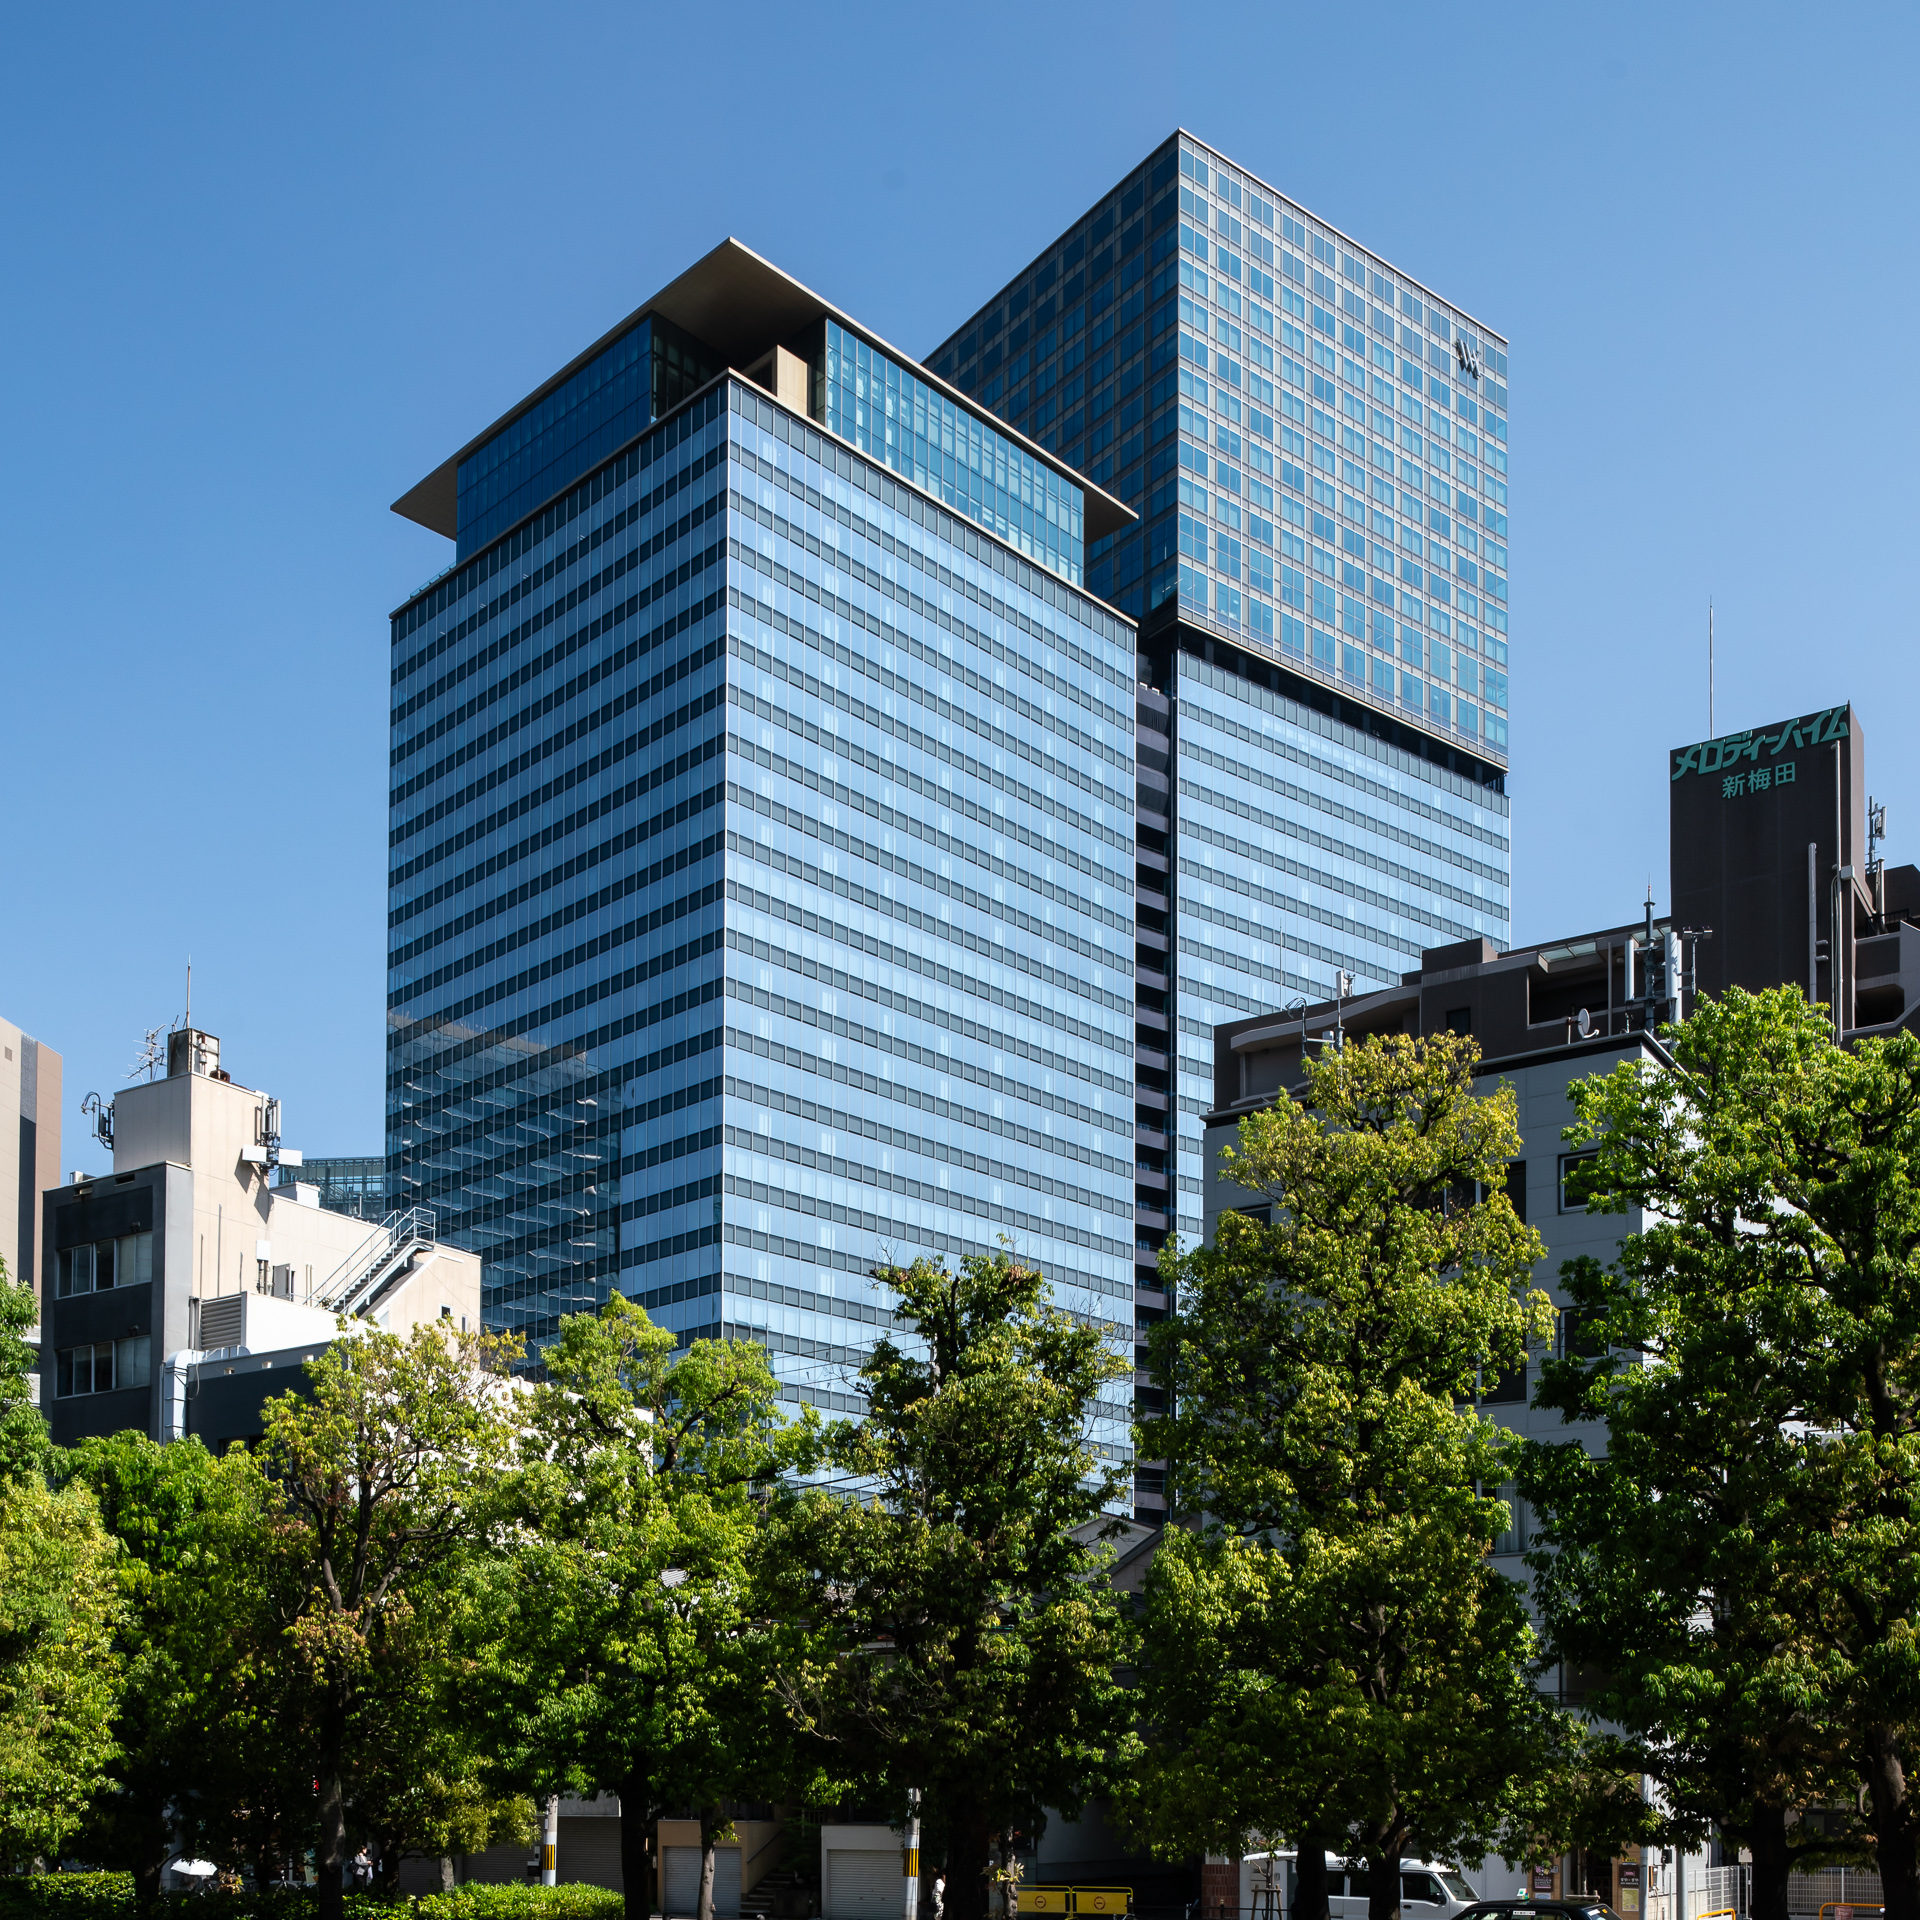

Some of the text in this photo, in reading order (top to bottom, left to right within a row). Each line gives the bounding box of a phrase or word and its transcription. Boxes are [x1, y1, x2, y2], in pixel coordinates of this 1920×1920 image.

[1671, 705, 1849, 781] メロディーハイム
[1722, 761, 1796, 799] 新梅田
